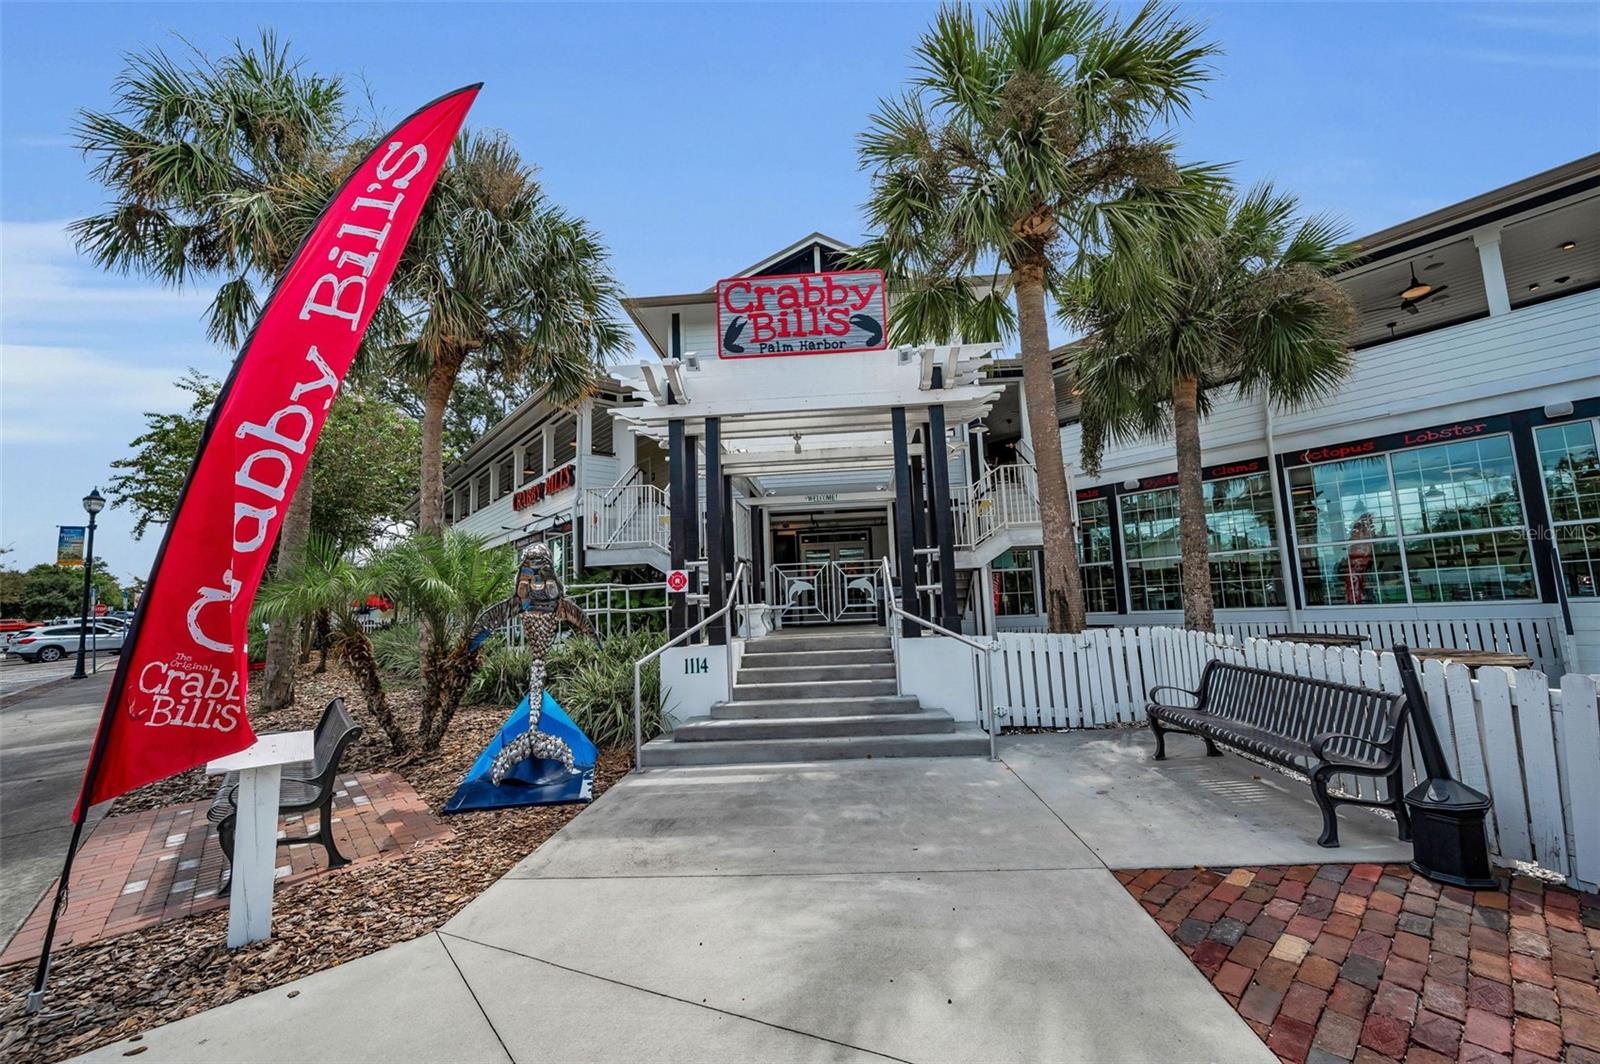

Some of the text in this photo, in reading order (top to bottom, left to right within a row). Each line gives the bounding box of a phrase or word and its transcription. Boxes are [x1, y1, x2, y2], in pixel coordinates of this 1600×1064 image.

[724, 276, 877, 314] Crabby
[760, 339, 847, 353] Palm Harbor
[1403, 422, 1488, 445] Lobster
[1211, 461, 1260, 477] Clams
[176, 652, 192, 662] The
[170, 660, 213, 673] Original
[684, 656, 709, 675] 1114
